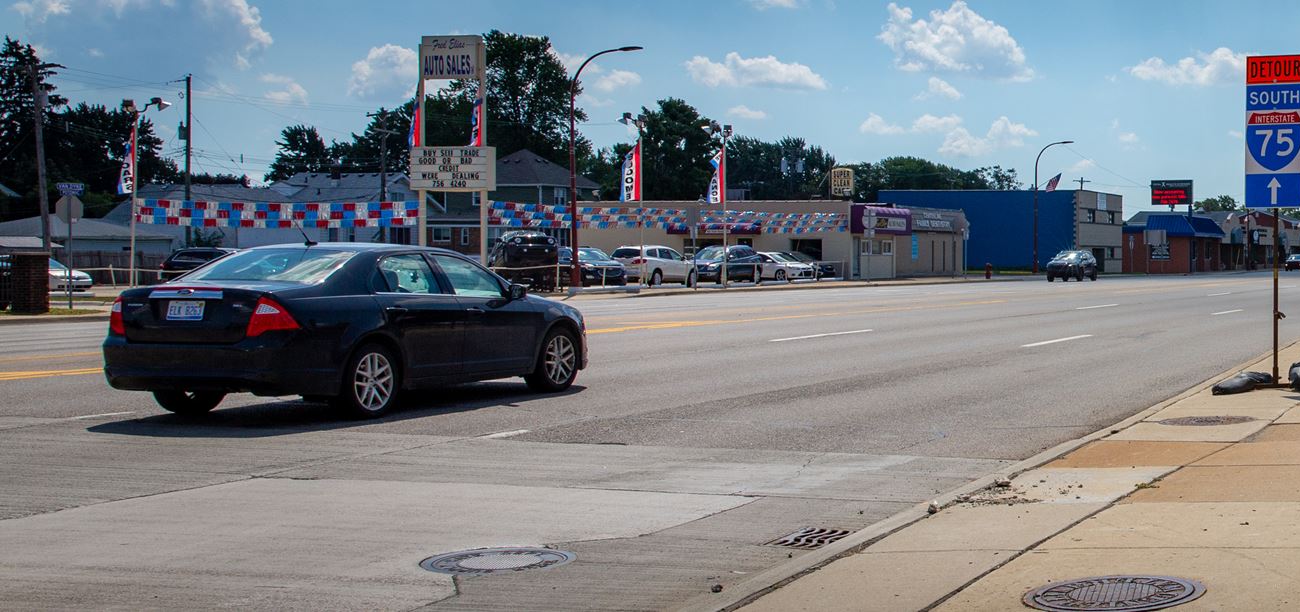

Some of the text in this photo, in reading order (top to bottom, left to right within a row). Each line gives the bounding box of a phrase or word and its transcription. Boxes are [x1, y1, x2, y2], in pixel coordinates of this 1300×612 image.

[424, 56, 444, 75] AUTO
[446, 54, 471, 75] SALES
[1251, 60, 1300, 78] DETOUR
[1250, 90, 1300, 105] SOUTH
[1255, 114, 1295, 123] INTERSTATE
[1255, 129, 1295, 157] 75
[460, 149, 480, 157] TRADE
[833, 170, 850, 178] SUPER
